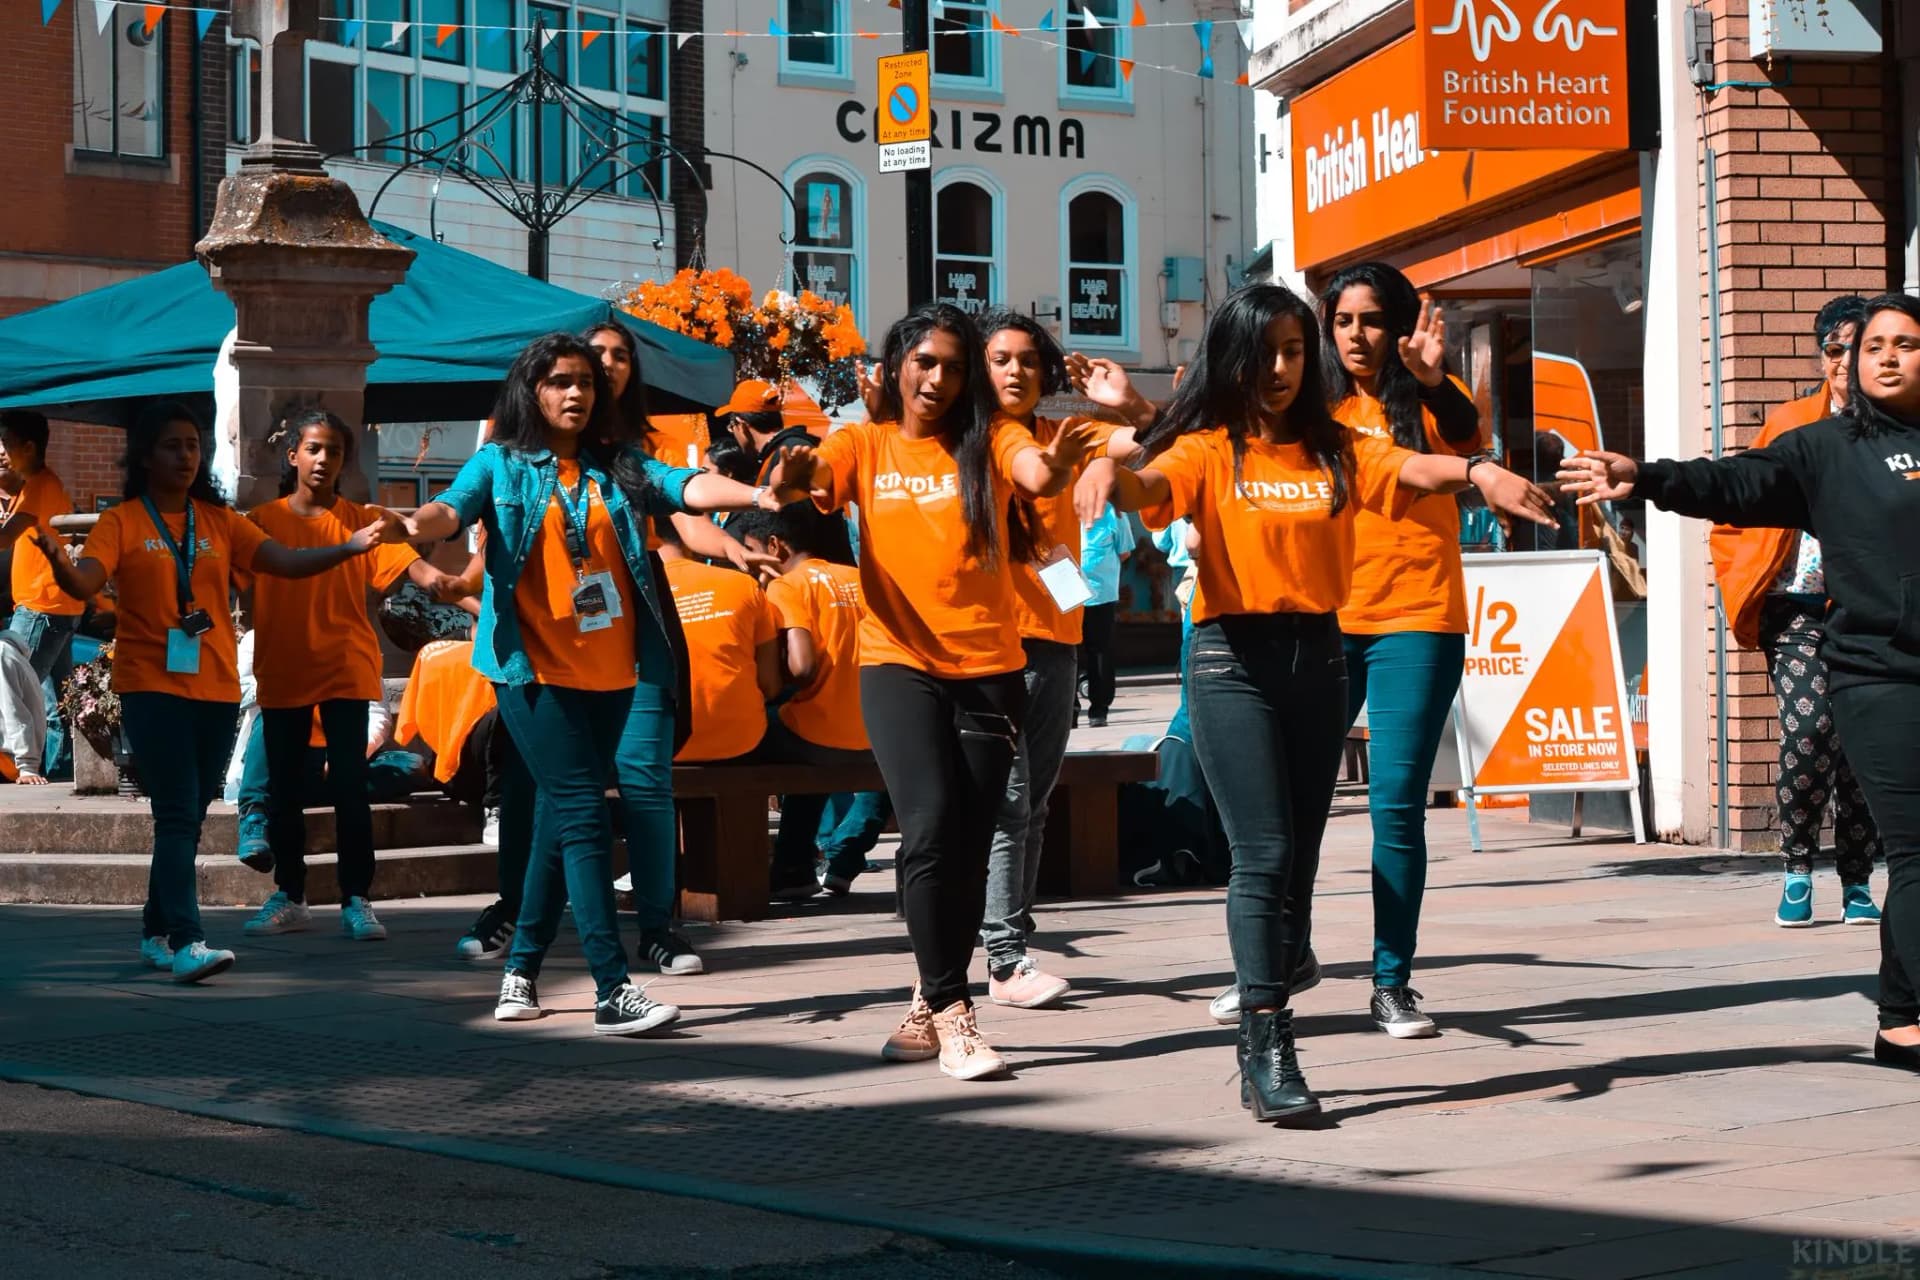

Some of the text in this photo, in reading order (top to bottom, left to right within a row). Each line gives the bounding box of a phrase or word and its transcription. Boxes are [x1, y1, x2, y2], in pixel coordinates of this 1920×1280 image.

[884, 58, 923, 69] Restricted
[894, 71, 912, 79] Zone
[1443, 69, 1609, 94] British Heart
[1443, 99, 1611, 125] Foundation
[883, 127, 926, 138] At any time
[884, 146, 926, 157] No loading
[883, 156, 926, 168] at any time
[1305, 118, 1368, 214] British
[1071, 303, 1118, 320] BEAUTY
[1884, 453, 1920, 472] KI
[874, 471, 957, 494] KINDLE
[1234, 480, 1333, 500] KINDLE
[1524, 706, 1617, 743] SALE
[1528, 742, 1617, 757] IN STORE NOW
[1542, 760, 1619, 772] SELECTED LINES ONLY
